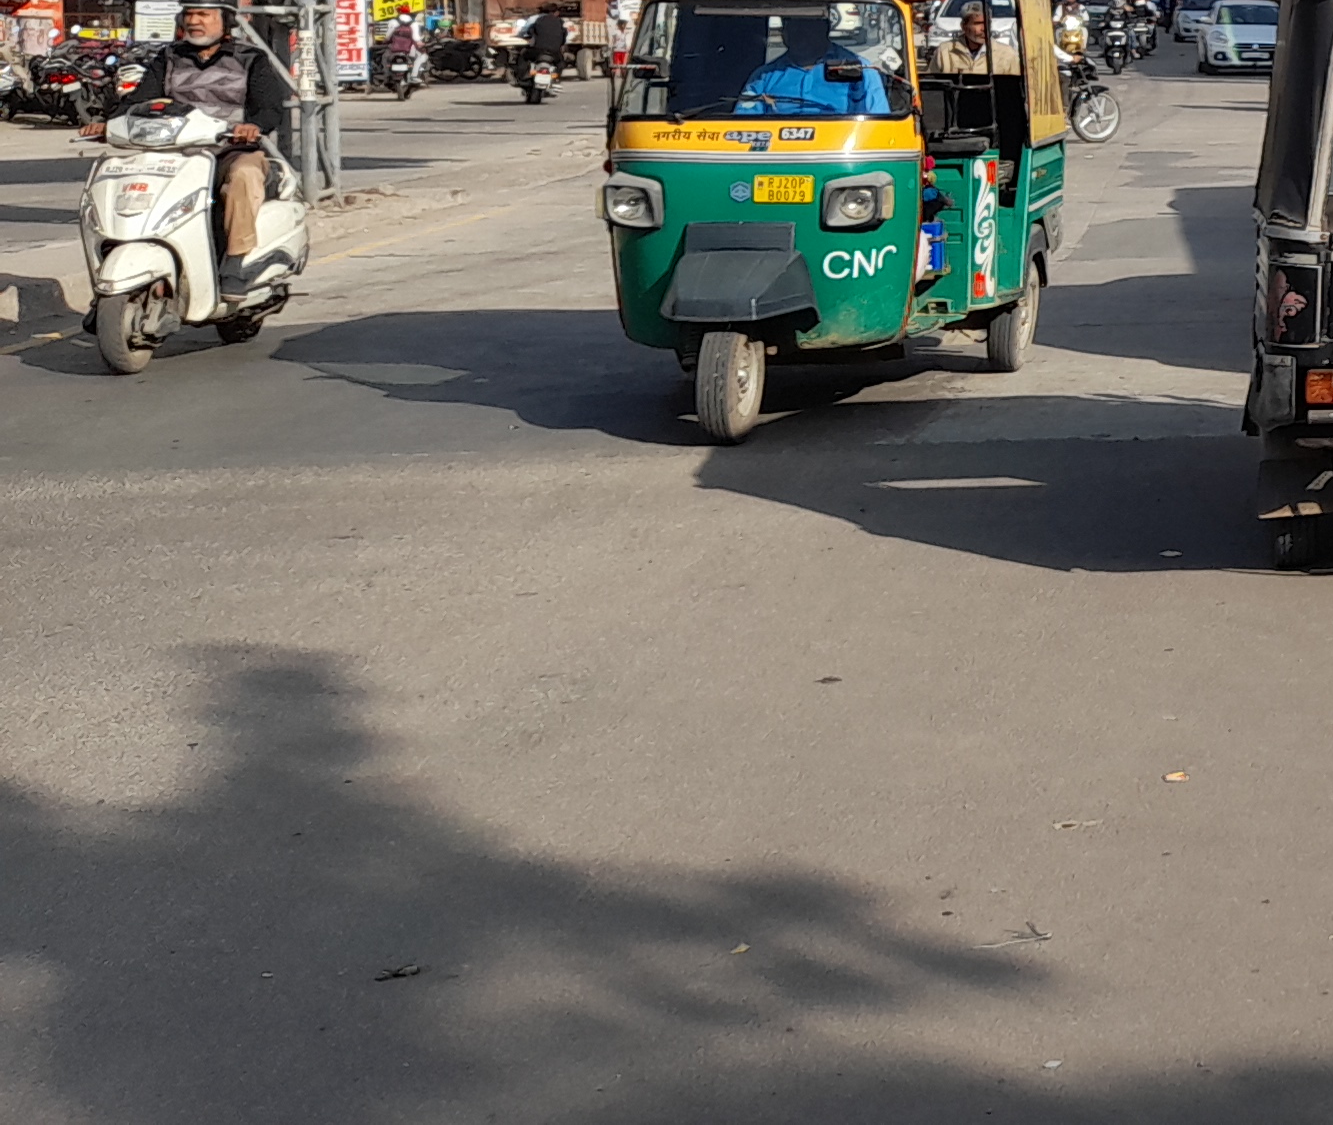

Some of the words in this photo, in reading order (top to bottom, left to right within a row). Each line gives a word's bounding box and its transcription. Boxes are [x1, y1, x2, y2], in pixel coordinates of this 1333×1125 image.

[652, 128, 693, 142] नगरीय
[696, 128, 720, 142] सेवा
[725, 130, 773, 143] ape
[780, 127, 814, 140] 6347
[767, 177, 806, 190] RJ20P
